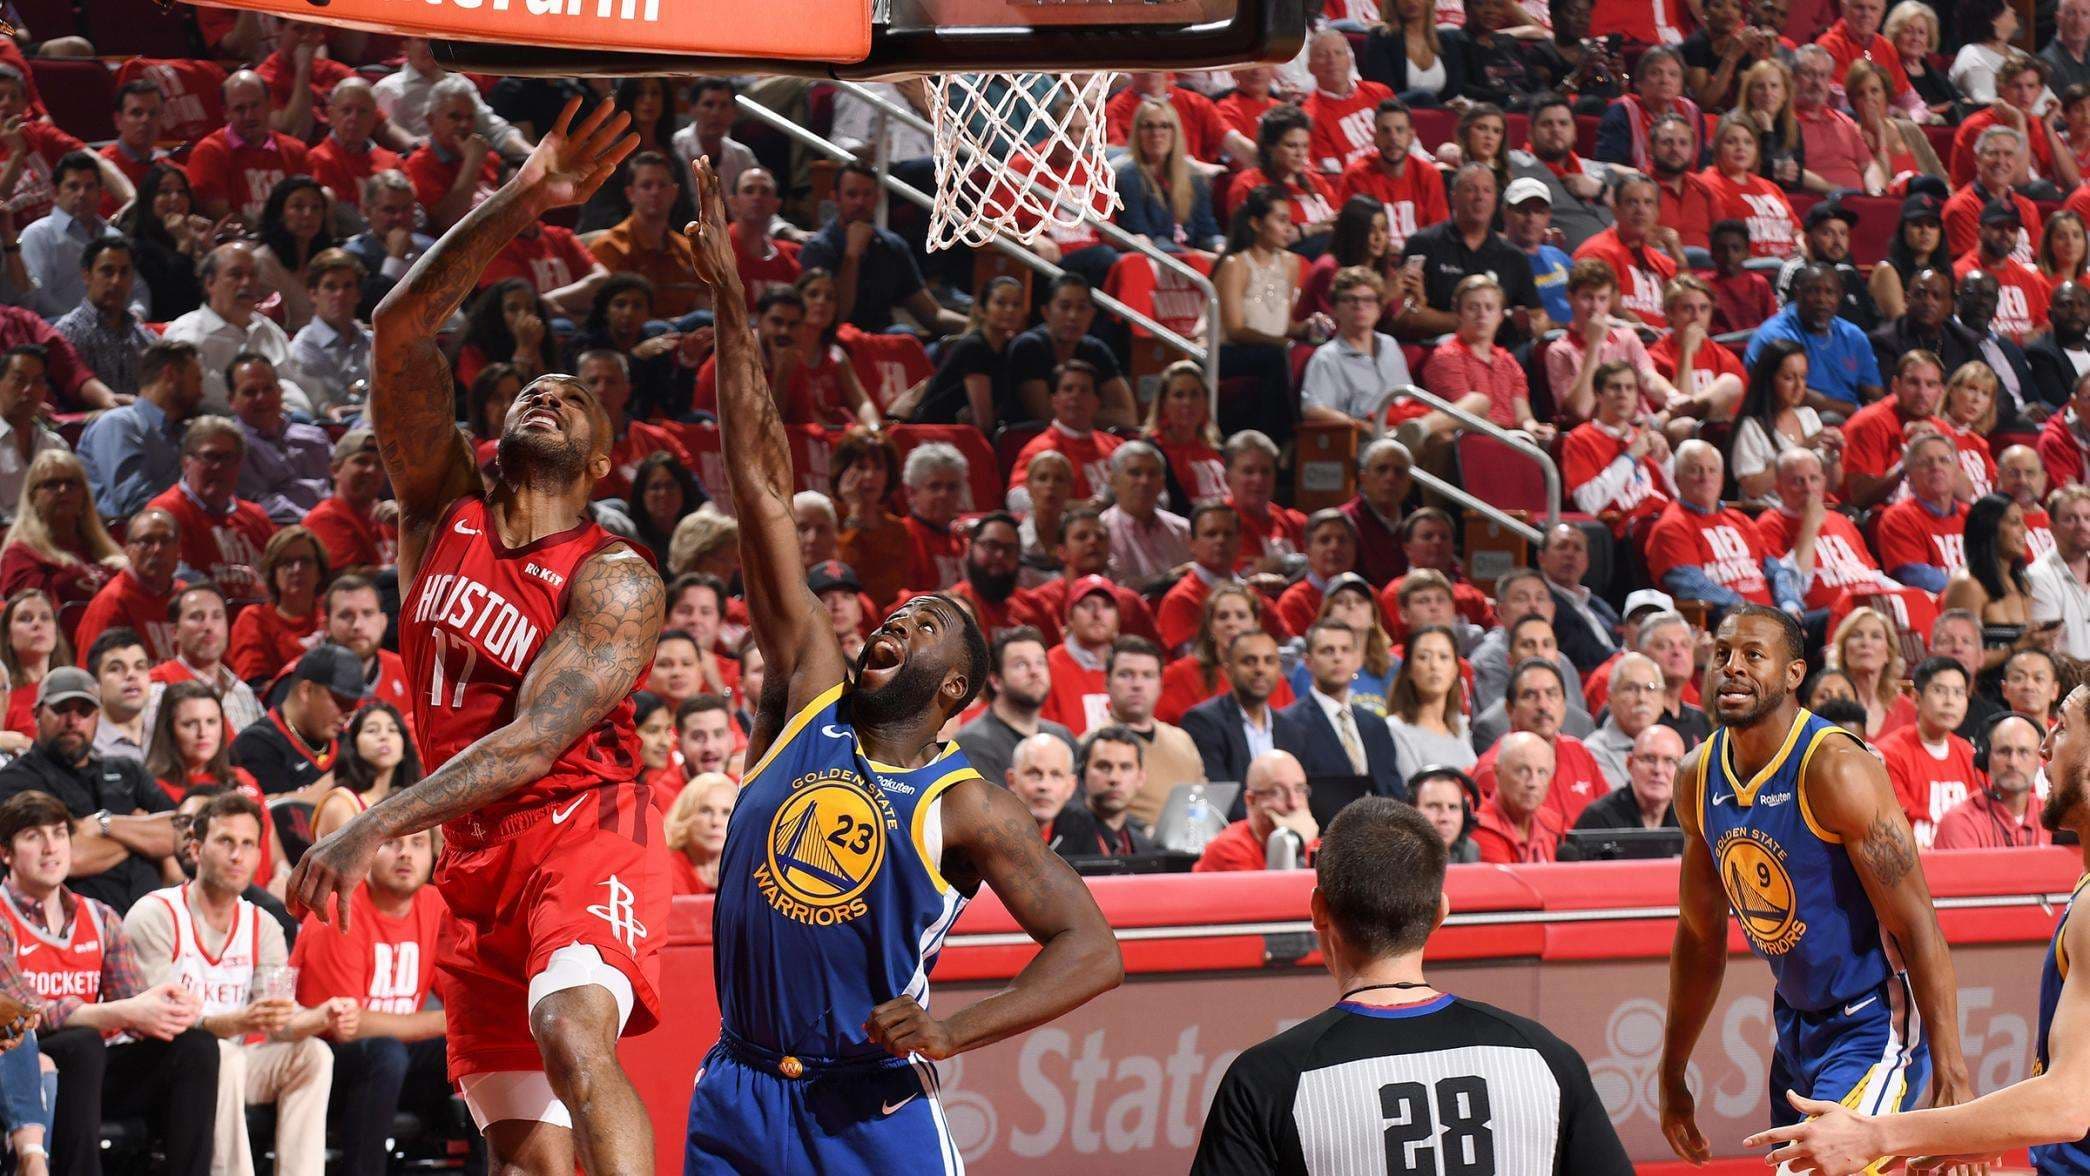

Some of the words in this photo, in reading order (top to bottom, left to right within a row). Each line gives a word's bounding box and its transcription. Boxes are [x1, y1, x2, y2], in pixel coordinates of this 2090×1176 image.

[431, 626, 477, 708] 17
[792, 768, 865, 789] GOLDEN
[867, 783, 898, 830] STATE
[1760, 791, 1791, 805] Rakuten
[828, 814, 874, 855] 23
[1715, 826, 1747, 858] GOLDEN
[1752, 829, 1788, 861] STATE
[752, 862, 868, 927] WARRIORS
[1756, 862, 1771, 888] 9
[1379, 1075, 1495, 1176] 28
